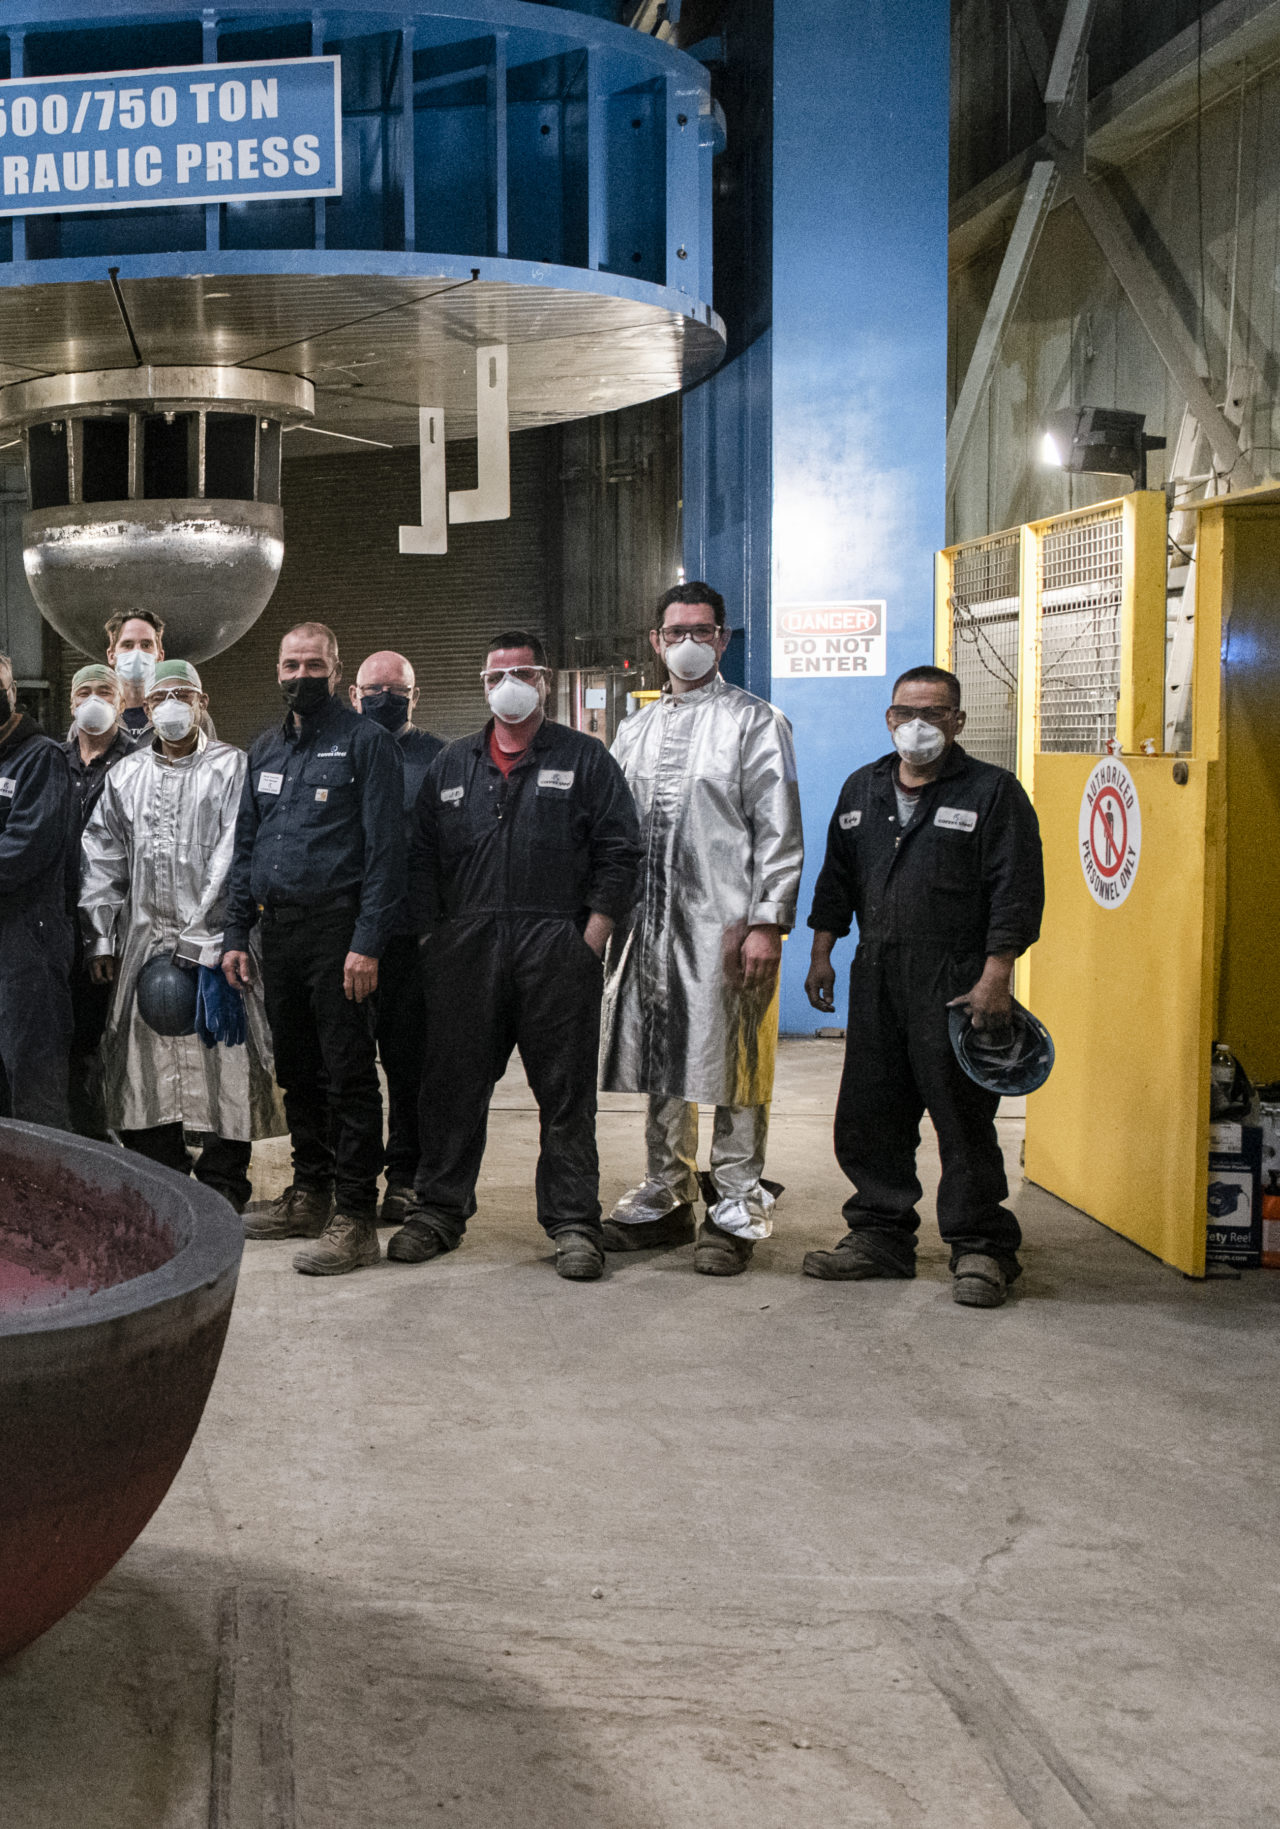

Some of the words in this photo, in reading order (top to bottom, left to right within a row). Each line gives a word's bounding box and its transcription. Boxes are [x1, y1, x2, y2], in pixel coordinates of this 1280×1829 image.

[190, 78, 278, 124] TON
[177, 134, 320, 184] PRESS
[788, 612, 871, 630] DANGER
[784, 639, 816, 655] DO
[826, 638, 875, 653] NOT
[790, 656, 867, 673] ENTER
[1086, 765, 1134, 810] AUTHORIZED
[1082, 839, 1120, 901] PERSONNEL
[1120, 846, 1137, 889] ONLY
[1207, 1230, 1227, 1245] ety
[1230, 1231, 1252, 1244] Reel
